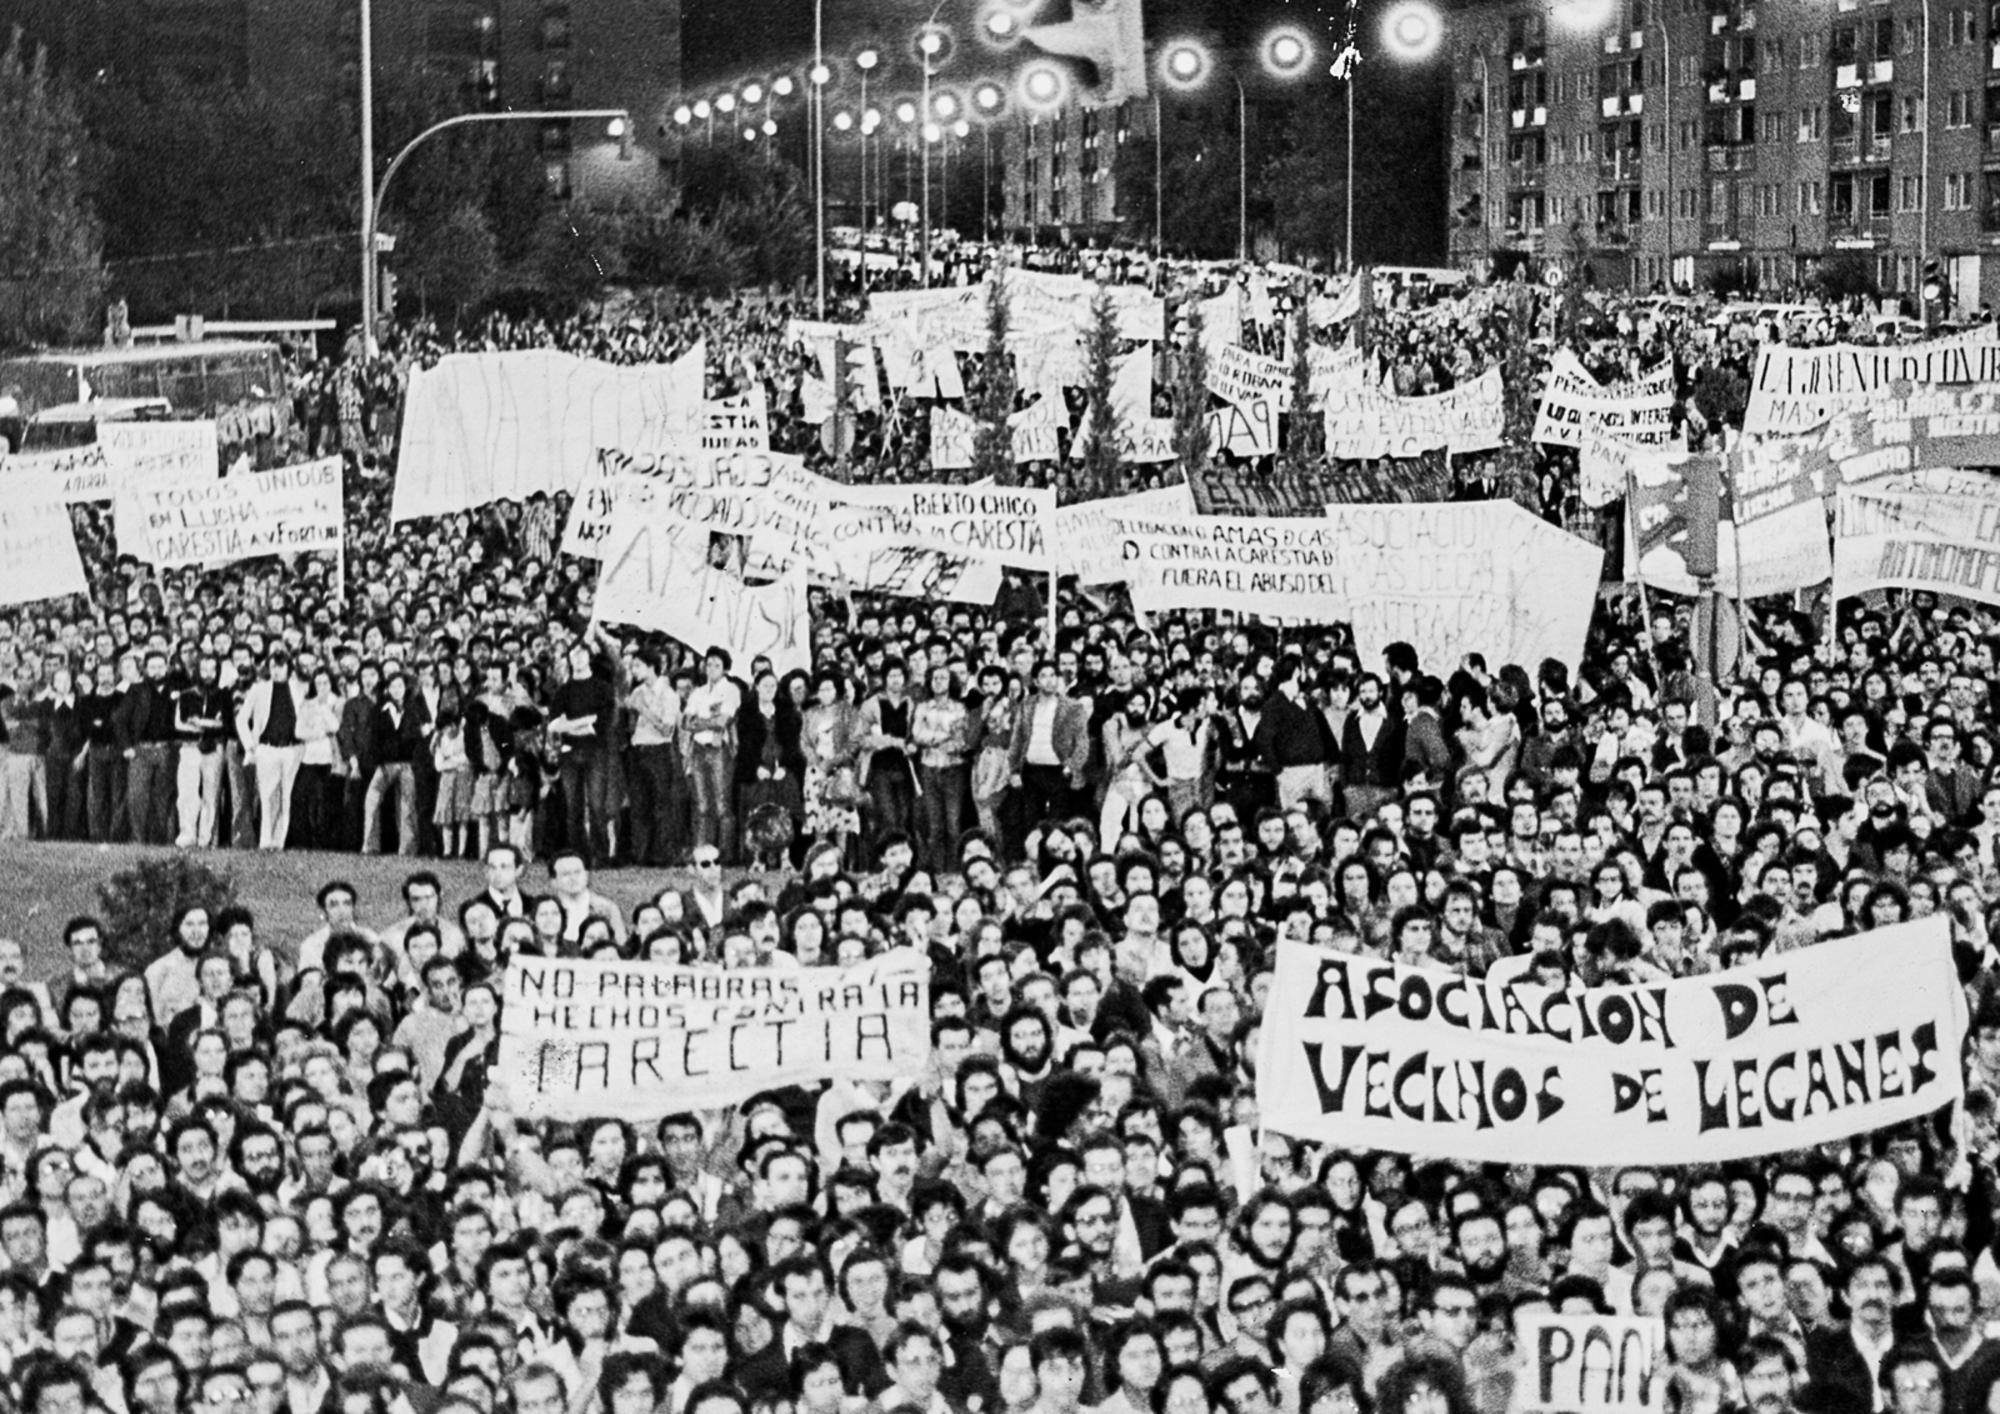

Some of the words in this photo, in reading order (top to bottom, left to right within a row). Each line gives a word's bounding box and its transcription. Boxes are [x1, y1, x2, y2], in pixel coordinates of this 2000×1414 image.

[180, 500, 259, 529] LUCHA
[980, 495, 1037, 518] CHICO
[950, 519, 1045, 557] CARESTIA
[1213, 524, 1278, 548] AMAS
[1162, 567, 1222, 590] FUERA
[1226, 570, 1247, 593] EL
[1250, 572, 1305, 595] ABUSO
[520, 968, 576, 999] NO
[600, 971, 799, 1000] PALABRAS
[533, 1004, 687, 1031] HECHOS
[882, 981, 921, 1010] LA
[1303, 958, 1678, 1049] ASOCIACION
[1711, 972, 1799, 1040] DE
[1302, 1041, 1565, 1130] VECINOS
[1612, 1067, 1670, 1122] DE
[1694, 1019, 1938, 1135] LEGANES
[1538, 1325, 1655, 1406] PAN
